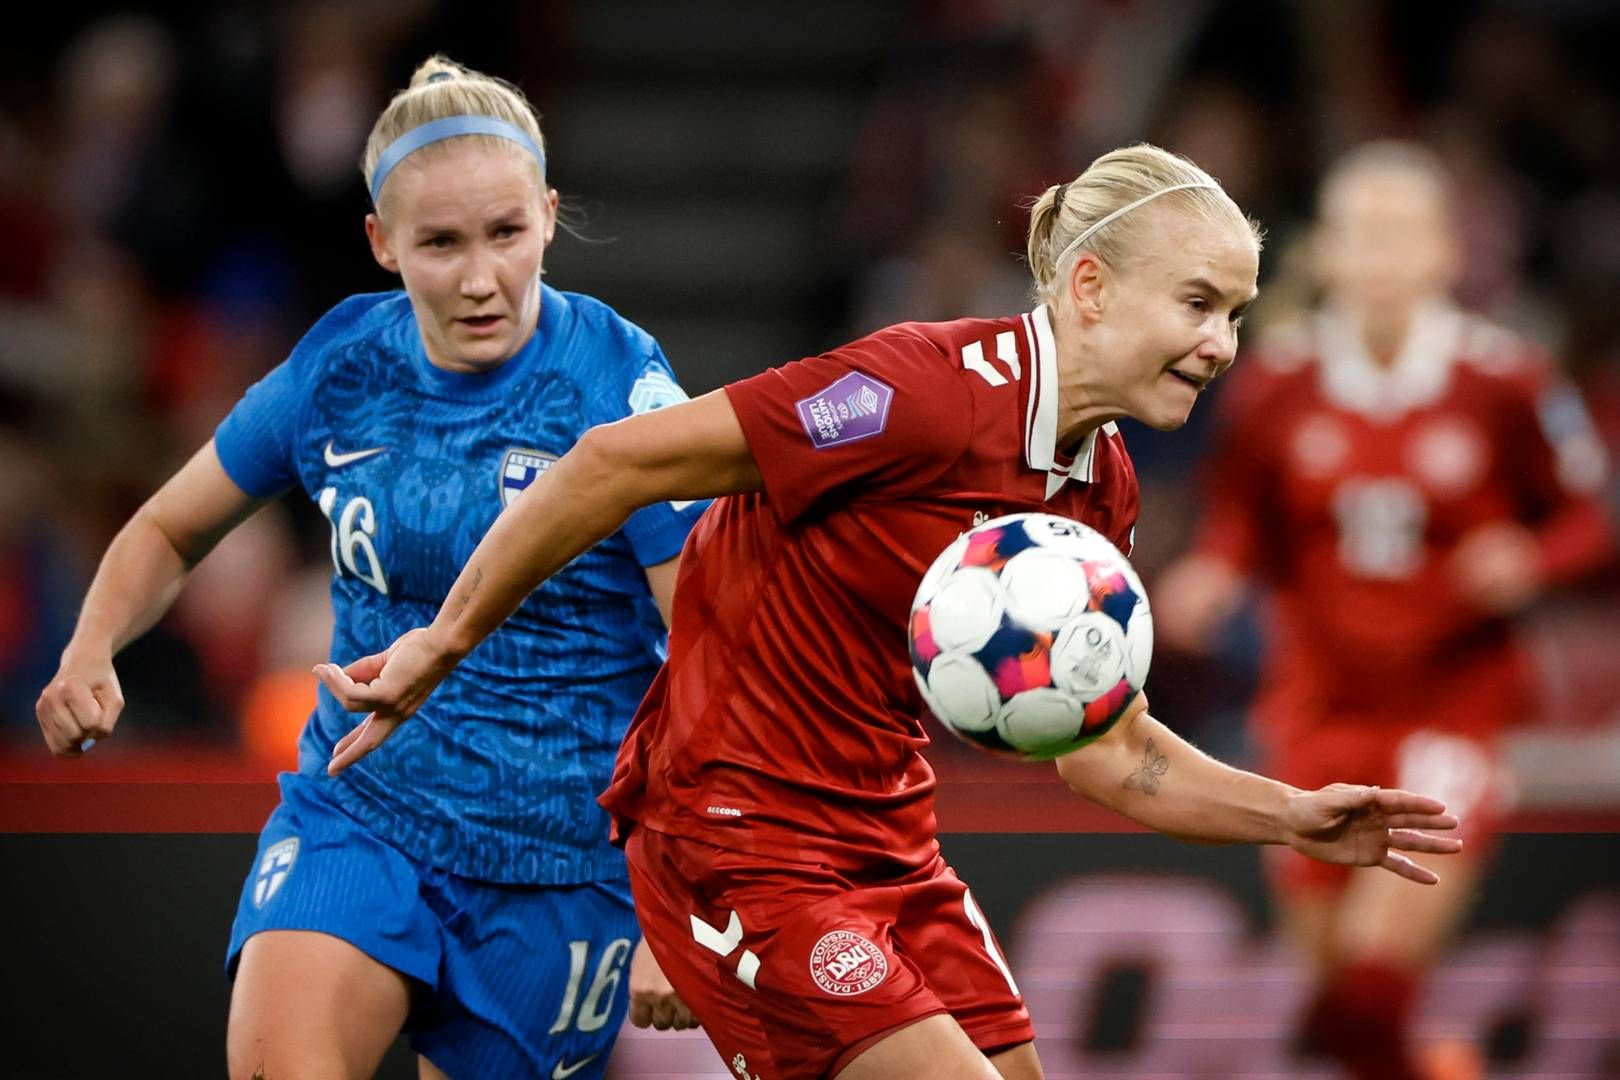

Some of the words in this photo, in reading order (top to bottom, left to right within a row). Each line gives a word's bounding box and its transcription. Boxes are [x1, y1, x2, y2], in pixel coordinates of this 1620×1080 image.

[809, 403, 830, 440] LEAGUE
[816, 398, 840, 439] NATIONS
[319, 487, 388, 595] 16
[814, 967, 851, 993] DANSK
[857, 971, 882, 991] 1889
[825, 944, 871, 980] DBU
[548, 938, 631, 1035] 16
